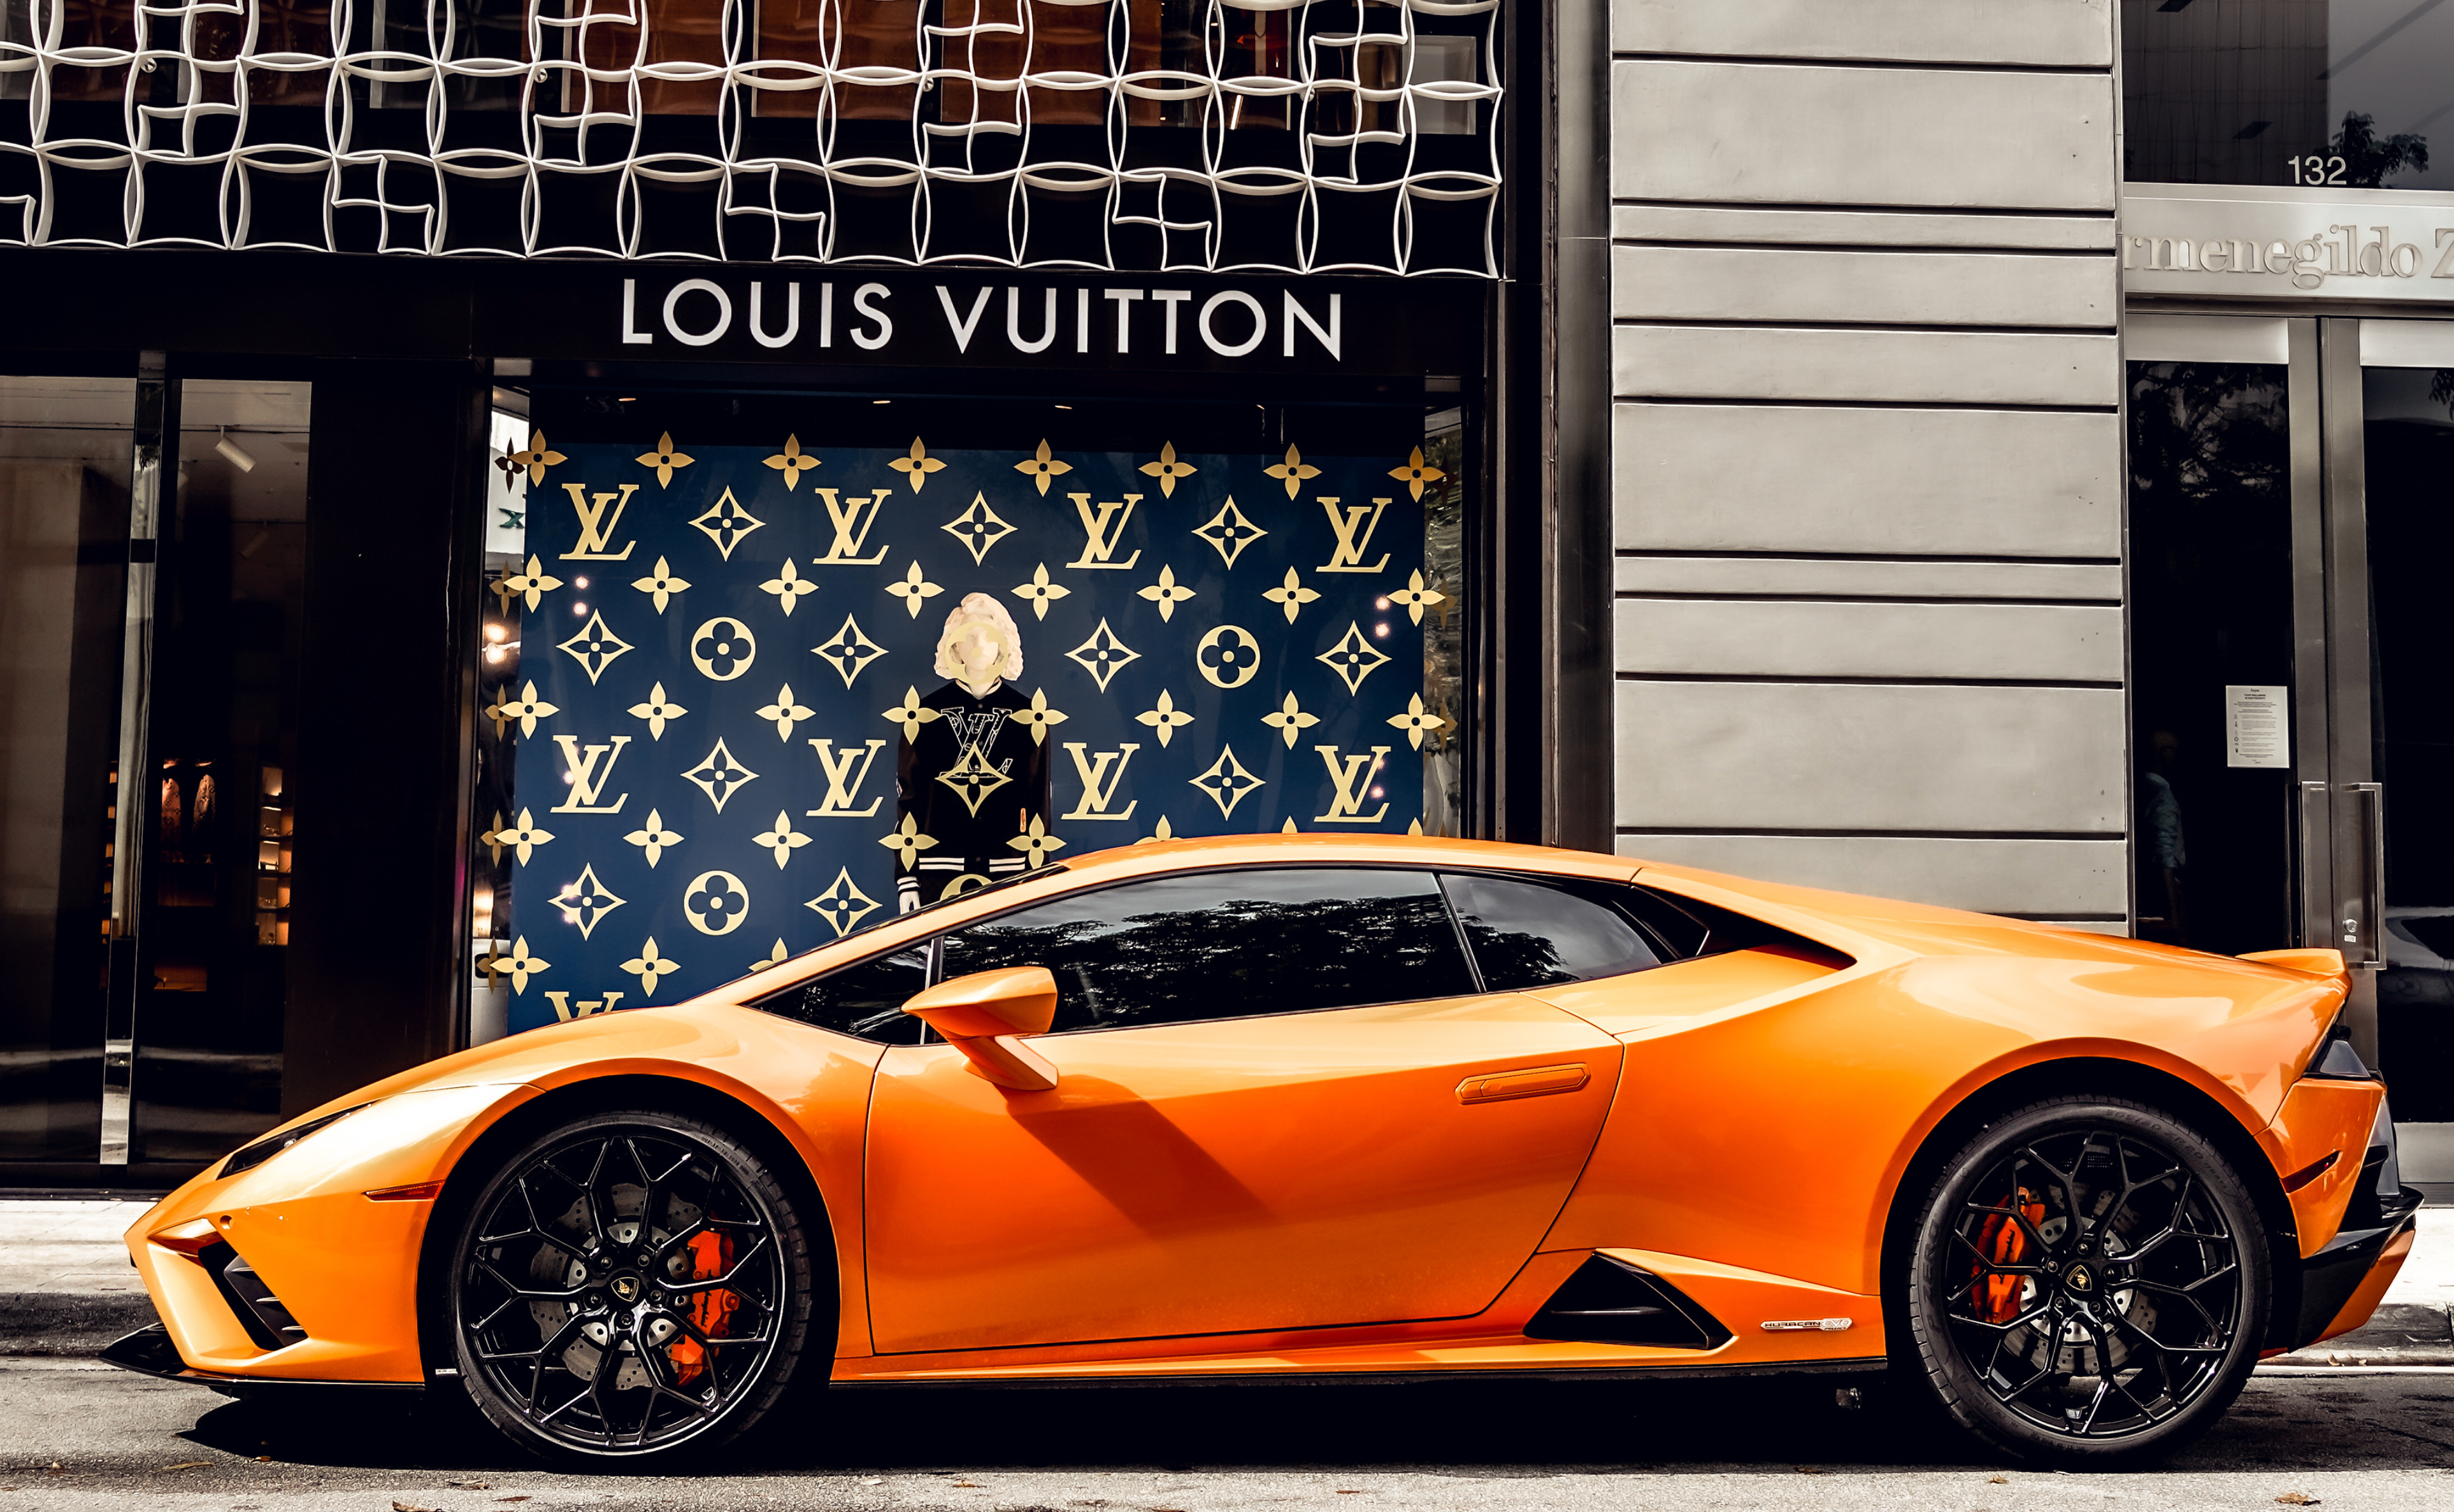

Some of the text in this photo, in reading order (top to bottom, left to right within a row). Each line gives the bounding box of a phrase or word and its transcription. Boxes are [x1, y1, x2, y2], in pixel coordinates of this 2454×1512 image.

[2288, 155, 2347, 185] 132
[2125, 224, 2423, 290] rmenegildo
[622, 278, 1341, 362] LOUIS VUITTON
